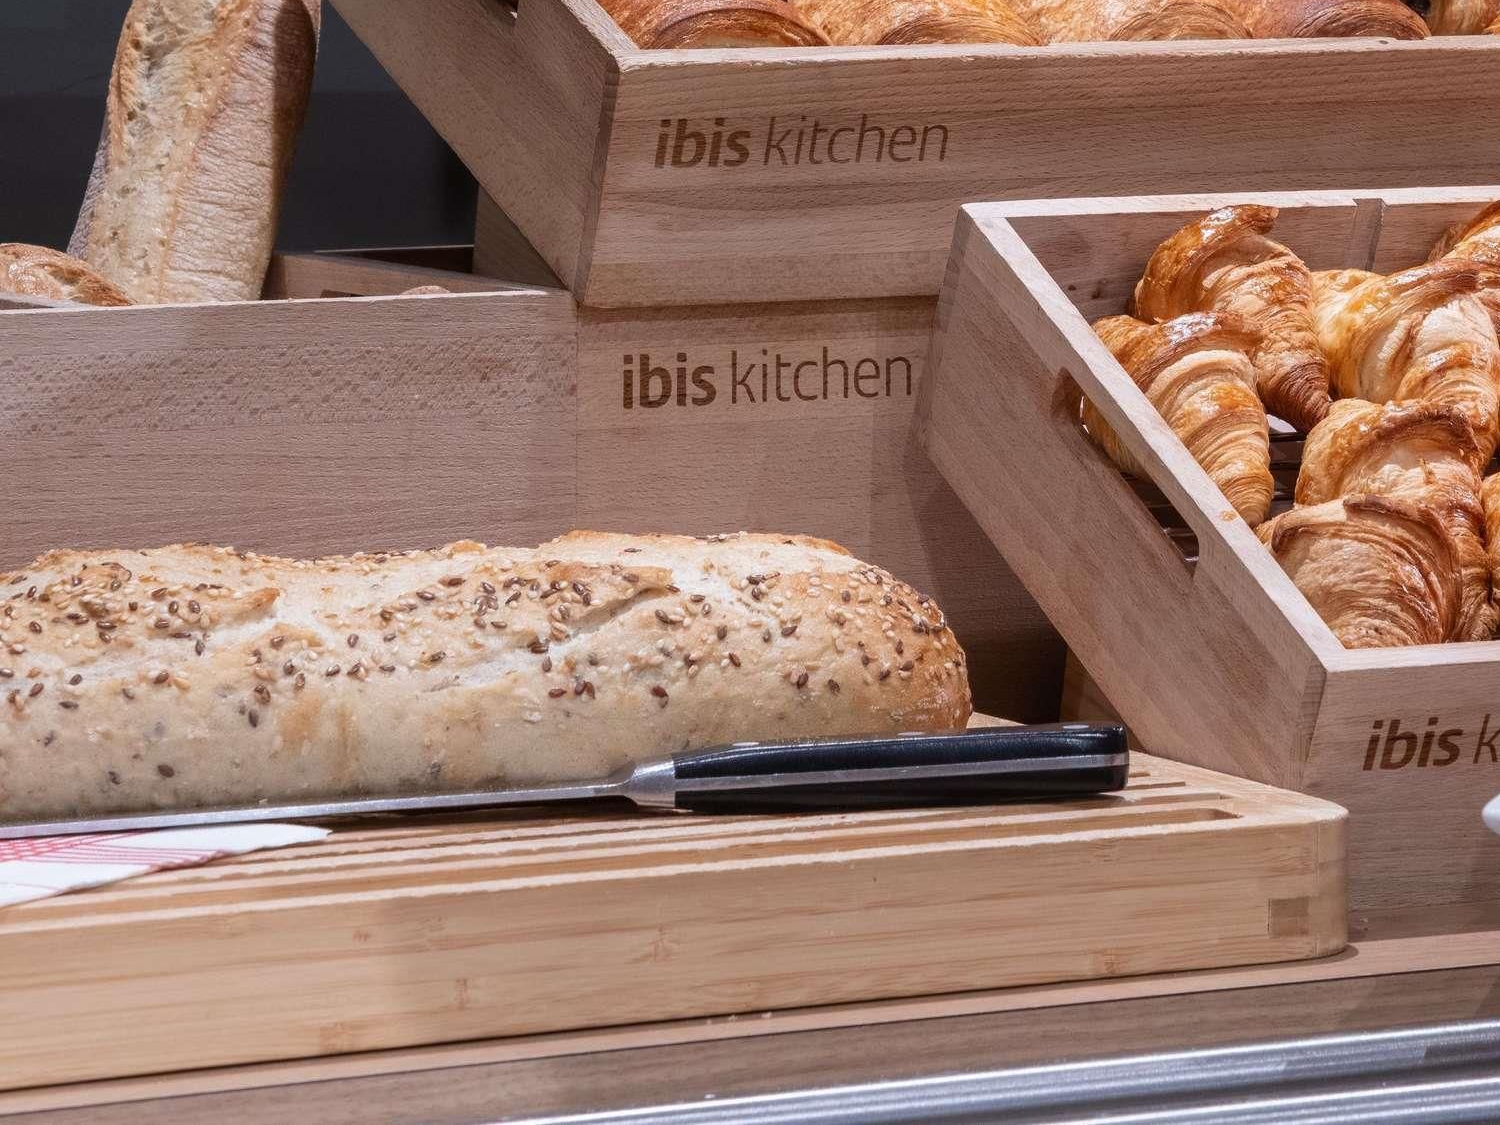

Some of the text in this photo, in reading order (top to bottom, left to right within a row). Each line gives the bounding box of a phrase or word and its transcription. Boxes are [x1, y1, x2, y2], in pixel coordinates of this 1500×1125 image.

[654, 114, 949, 168] ibis kitchen
[622, 346, 912, 410] ibis kitchen
[1363, 717, 1463, 771] ibis
